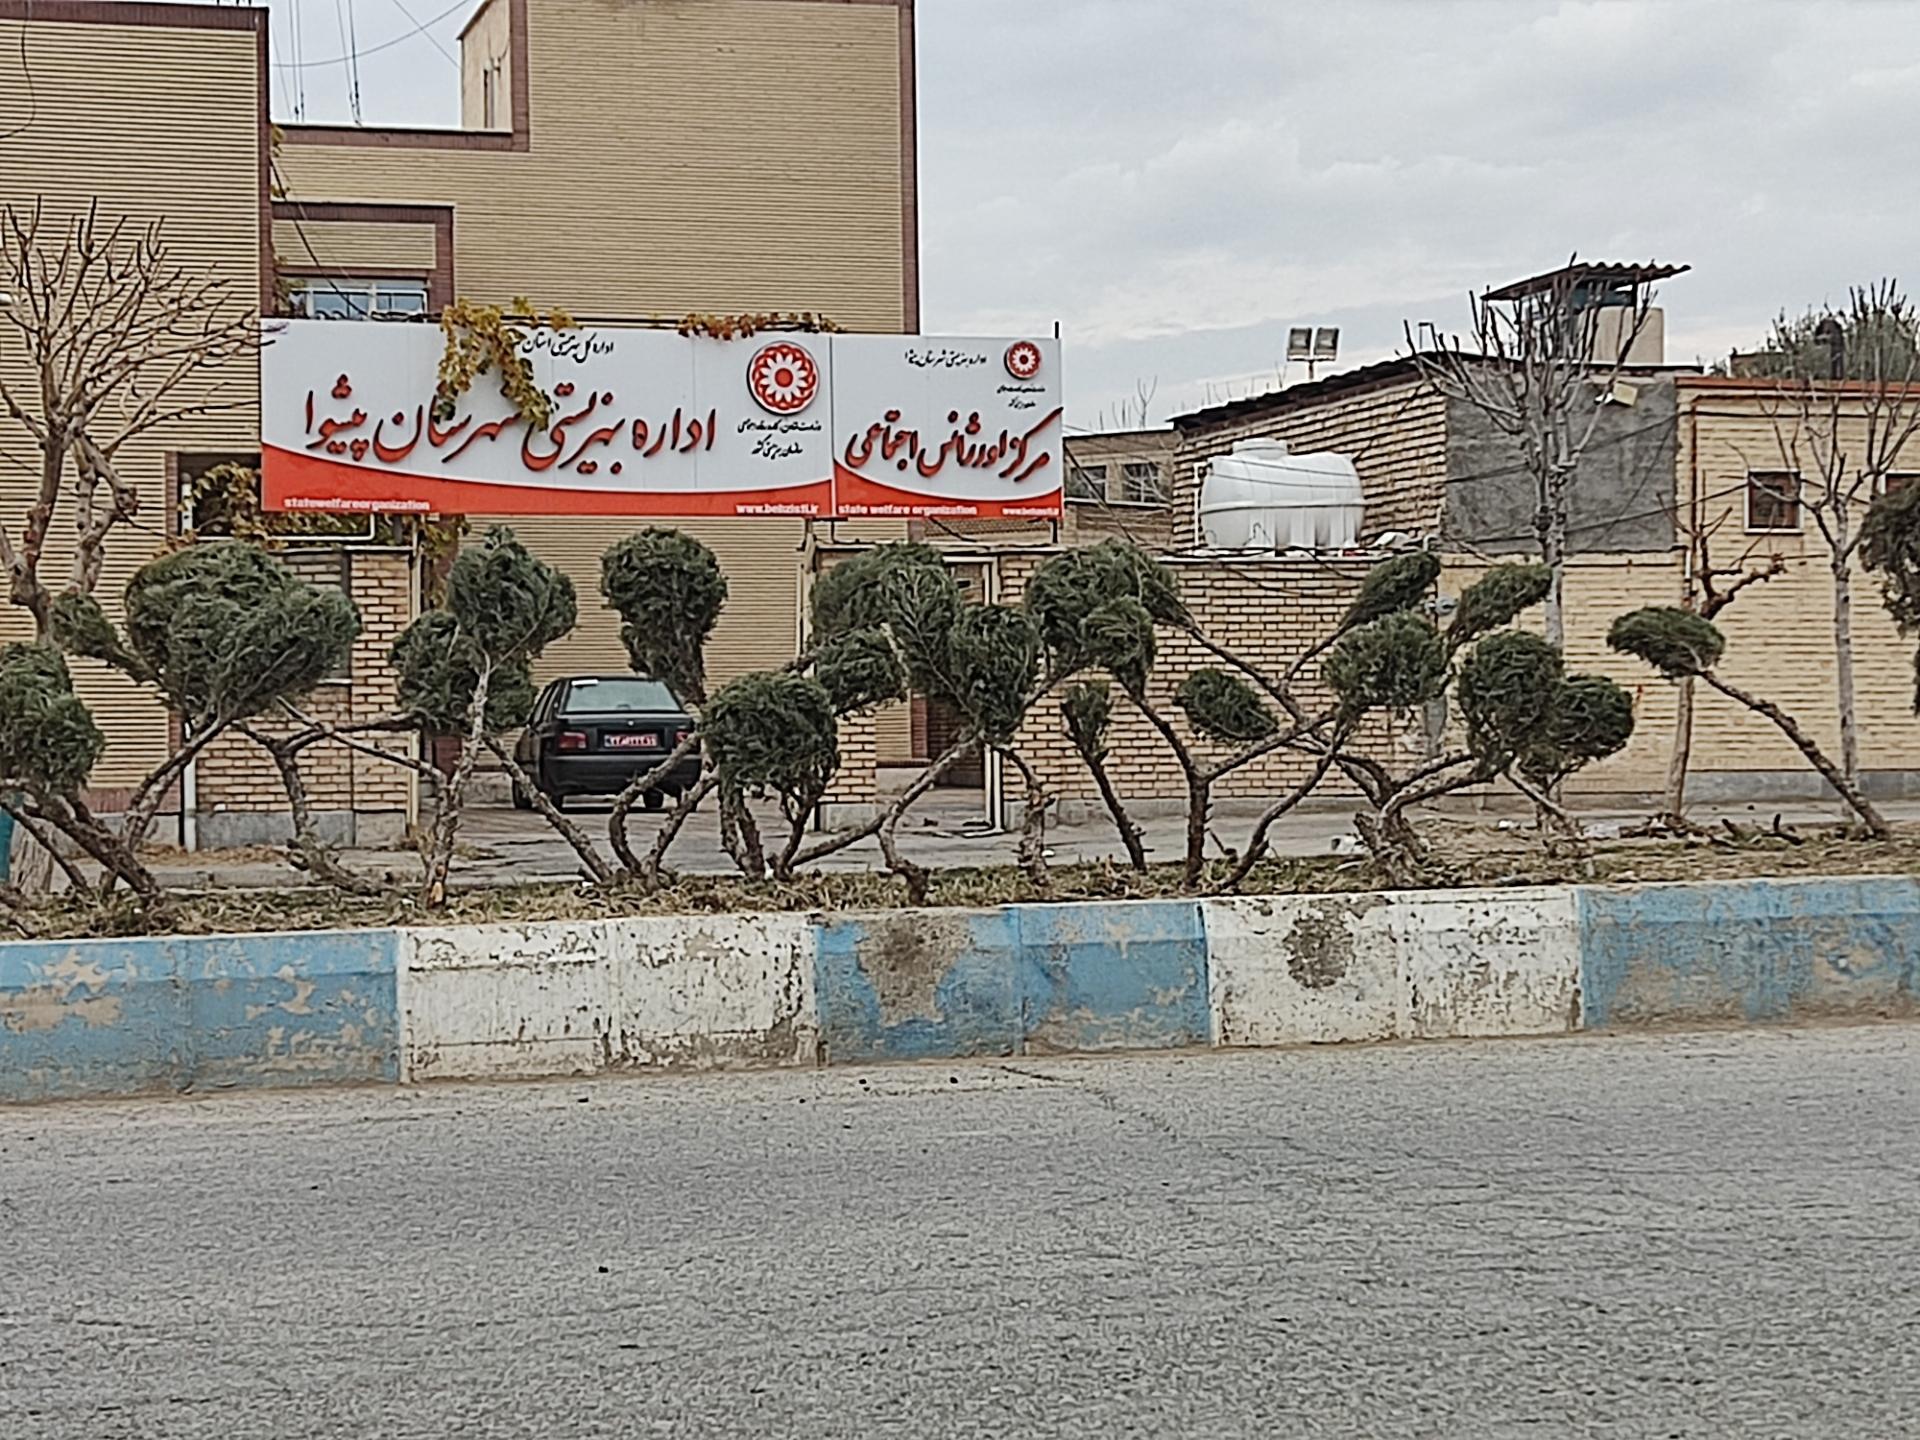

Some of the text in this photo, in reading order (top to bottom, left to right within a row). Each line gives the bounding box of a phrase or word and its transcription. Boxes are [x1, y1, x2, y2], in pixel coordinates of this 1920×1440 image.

[521, 331, 552, 354] استان
[572, 332, 598, 363] کل
[592, 340, 614, 354] اداره
[305, 373, 371, 462] پیشوا
[521, 382, 627, 475] بهزیستی
[632, 407, 717, 459] اداره
[844, 406, 1064, 482] مرکز اورژانس اجتماعی
[838, 504, 869, 515] state
[869, 504, 911, 515] welfare
